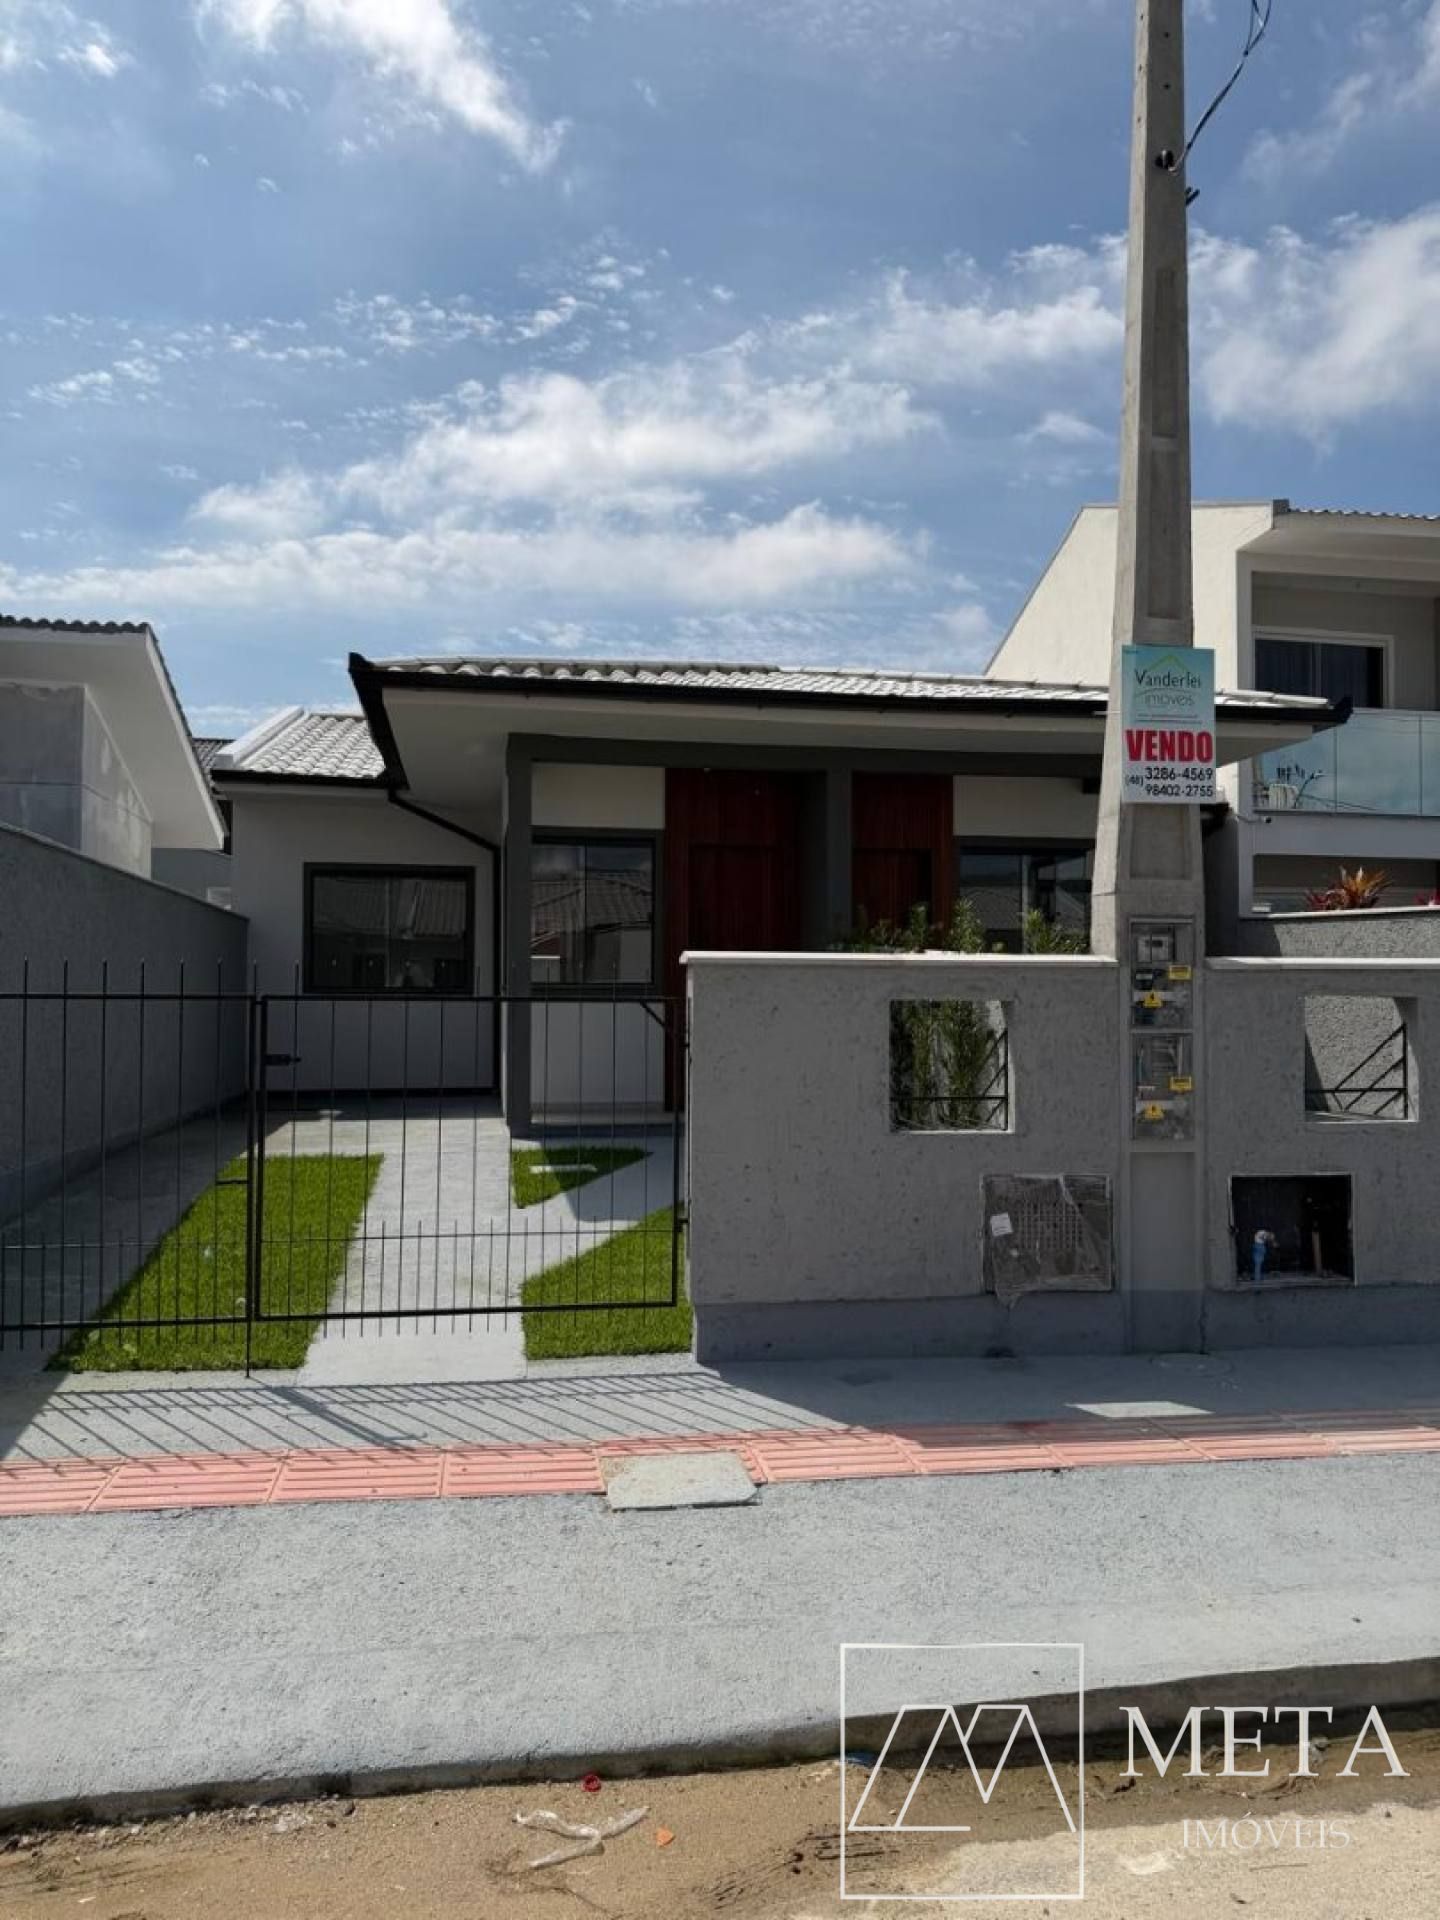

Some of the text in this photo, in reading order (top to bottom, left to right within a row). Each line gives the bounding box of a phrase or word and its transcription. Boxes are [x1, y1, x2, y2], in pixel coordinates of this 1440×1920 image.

[1134, 668, 1202, 688] Vanderlei
[1125, 730, 1213, 763] VENDO
[1145, 766, 1213, 781] 3286-4569
[1145, 784, 1213, 797] 98402-2755
